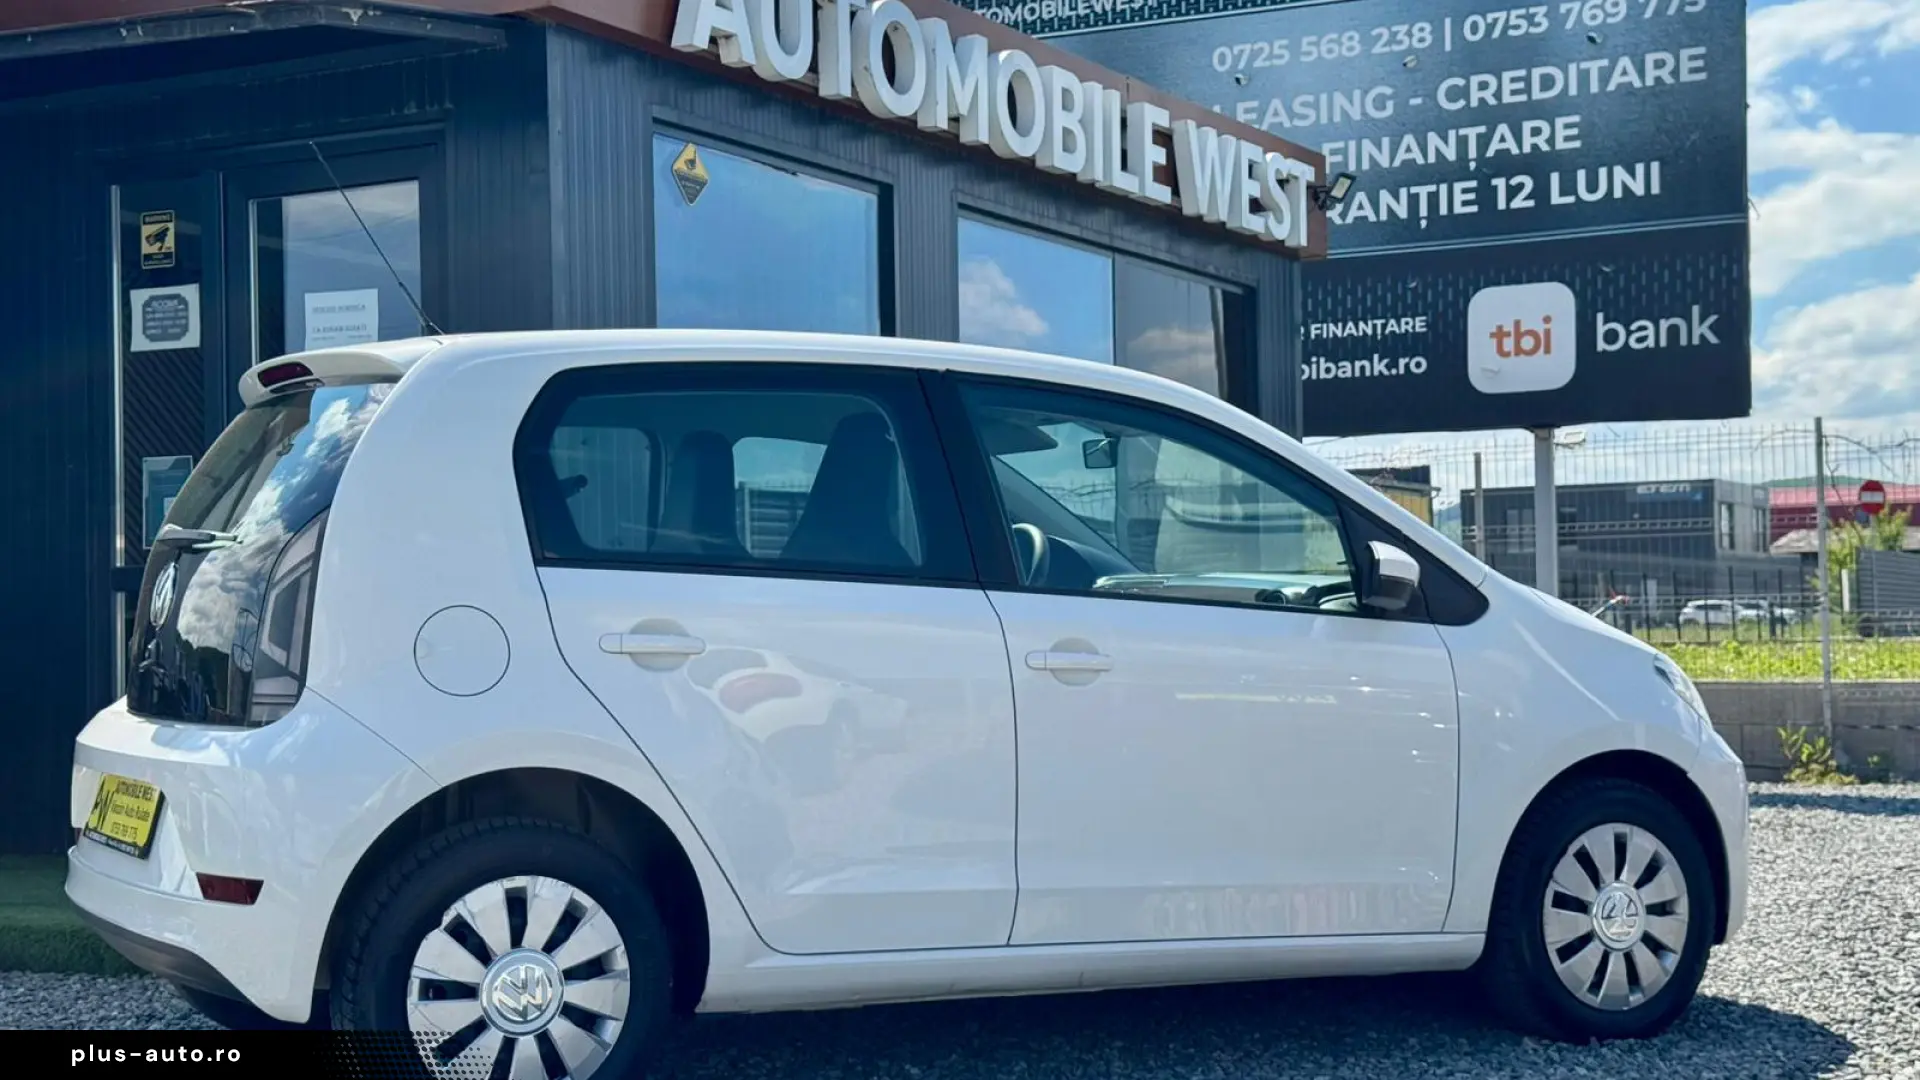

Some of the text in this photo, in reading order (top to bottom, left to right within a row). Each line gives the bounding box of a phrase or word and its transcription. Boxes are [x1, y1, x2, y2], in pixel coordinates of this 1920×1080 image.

[1212, 39, 1290, 72] 0725
[1300, 31, 1361, 62] 568
[1370, 22, 1433, 55] 238
[1462, 4, 1550, 43] 0753
[1559, 0, 1627, 30] 769
[1213, 86, 1395, 130] EASING
[1437, 46, 1708, 111] CREDITARE
[671, 0, 1315, 247] AUTOMOBILE WEST
[1322, 115, 1582, 175] FINANȚARE
[1492, 174, 1534, 210] 12
[1551, 162, 1661, 206] LUNI
[1310, 316, 1428, 341] FINANȚARE
[1489, 305, 1720, 359] tbi bank
